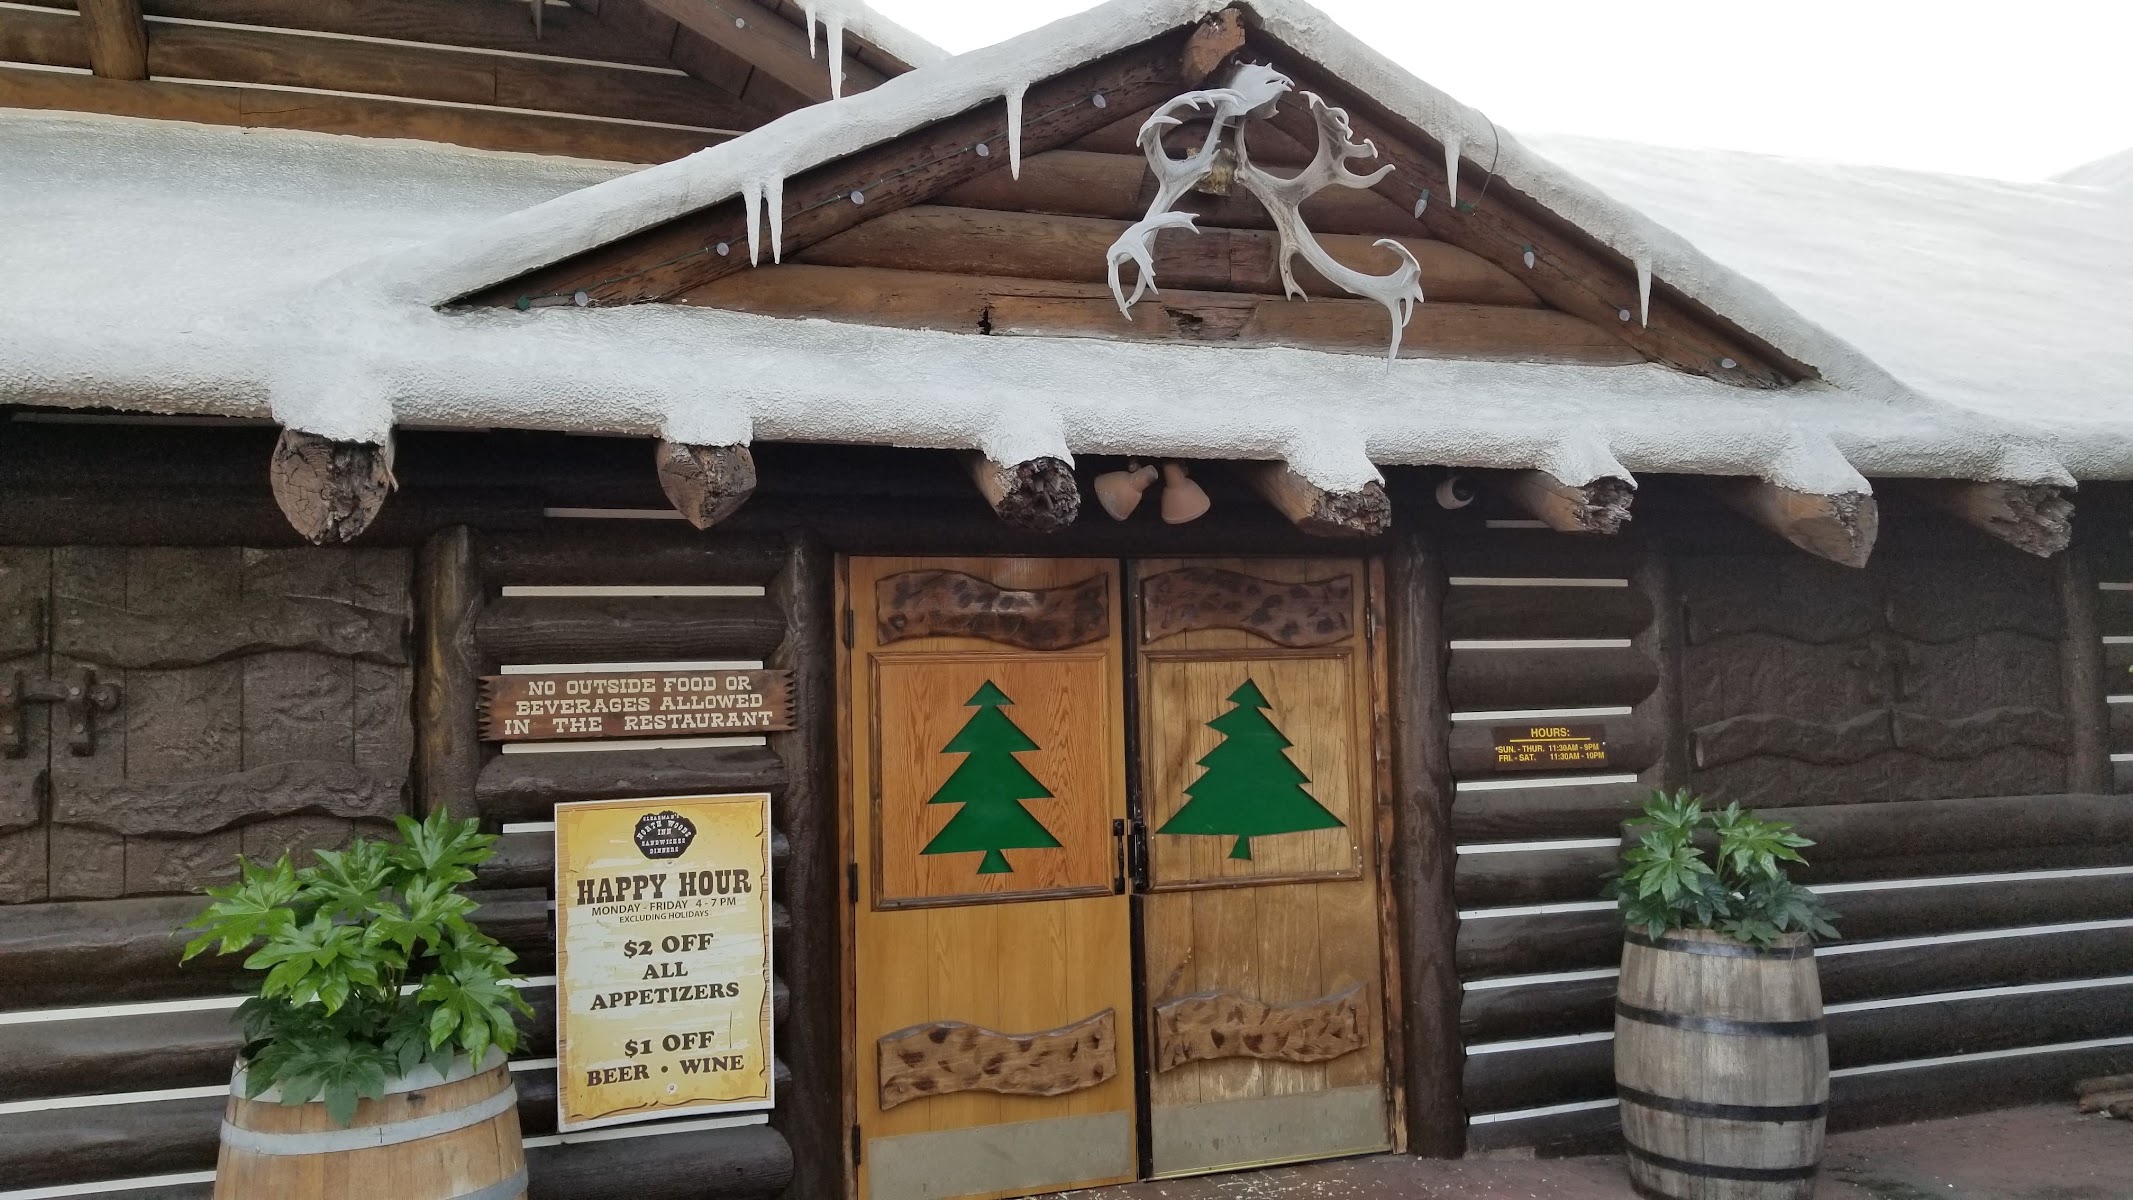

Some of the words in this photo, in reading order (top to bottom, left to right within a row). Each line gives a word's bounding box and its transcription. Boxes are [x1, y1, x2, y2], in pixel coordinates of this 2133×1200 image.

[529, 681, 555, 695] NO
[567, 679, 656, 694] OUTSIDE
[664, 677, 717, 692] FOOD
[726, 676, 751, 691] OR
[516, 698, 650, 716] BEVERAGES
[660, 694, 763, 711] ALLOWED
[504, 719, 529, 735] IN
[553, 717, 602, 733] THE
[625, 711, 772, 730] RESTAURANT
[1531, 728, 1570, 737] HOURS:
[637, 821, 662, 840] NORTH
[668, 820, 691, 837] WOODS
[642, 838, 686, 846] SANDWICHES
[577, 874, 667, 905] HAPPY
[679, 869, 752, 897] HOUR
[592, 904, 640, 916] MONDAY
[650, 900, 688, 911] FRIDAY
[711, 898, 716, 906] 7
[720, 898, 736, 906] PM
[620, 913, 666, 924] EXCLUDING
[669, 910, 709, 919] HOLIDAYS
[624, 940, 653, 959] $2
[661, 933, 714, 953] OFF
[642, 962, 688, 980] ALL
[590, 982, 739, 1011] APPETIZERS
[624, 1039, 652, 1058] $1
[662, 1031, 714, 1051] OFF
[587, 1064, 650, 1087] BEER
[679, 1055, 744, 1074] WINE
